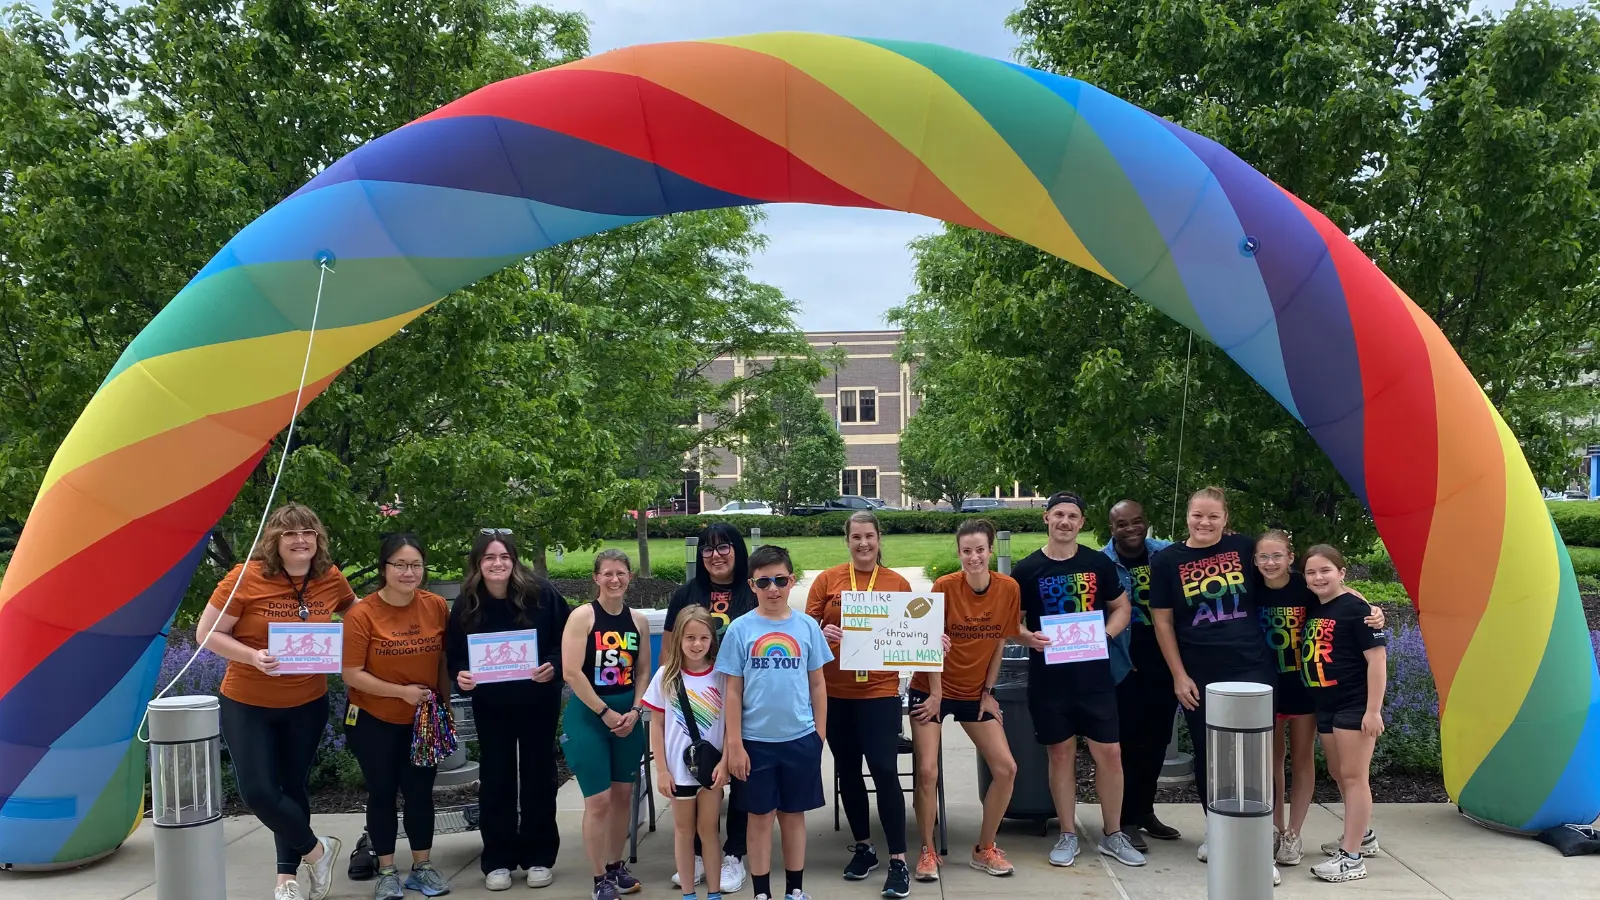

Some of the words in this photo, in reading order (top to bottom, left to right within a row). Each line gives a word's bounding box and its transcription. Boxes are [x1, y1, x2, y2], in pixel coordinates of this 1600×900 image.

[1179, 551, 1240, 573] SCHREIBER
[1039, 572, 1097, 587] SCHREIBER
[1180, 559, 1242, 585] FOODS
[1040, 581, 1097, 599] FOODS
[1183, 571, 1247, 606] FOR
[845, 592, 865, 602] run
[870, 591, 892, 603] like
[1042, 593, 1095, 615] FOR
[268, 602, 298, 610] DOING
[305, 600, 325, 608] OOD
[843, 604, 889, 615] JORDAN
[1192, 593, 1247, 626] ALL
[263, 609, 300, 618] THROUG
[843, 617, 871, 627] LOVE
[951, 624, 978, 632] DOING
[1259, 615, 1306, 629] OODS
[594, 631, 638, 651] LOVE
[886, 629, 929, 646] throwing
[1302, 626, 1334, 642] OODS
[375, 647, 418, 656] THROUGH
[381, 640, 409, 648] DOING
[874, 638, 892, 651] you
[1302, 640, 1333, 663] OR
[595, 649, 618, 667] IS
[751, 657, 770, 669] BE
[772, 657, 801, 669] YOU
[883, 649, 913, 661] HAIL
[916, 649, 943, 662] MARY
[594, 666, 632, 686] LOVE
[1303, 662, 1338, 687] LL
